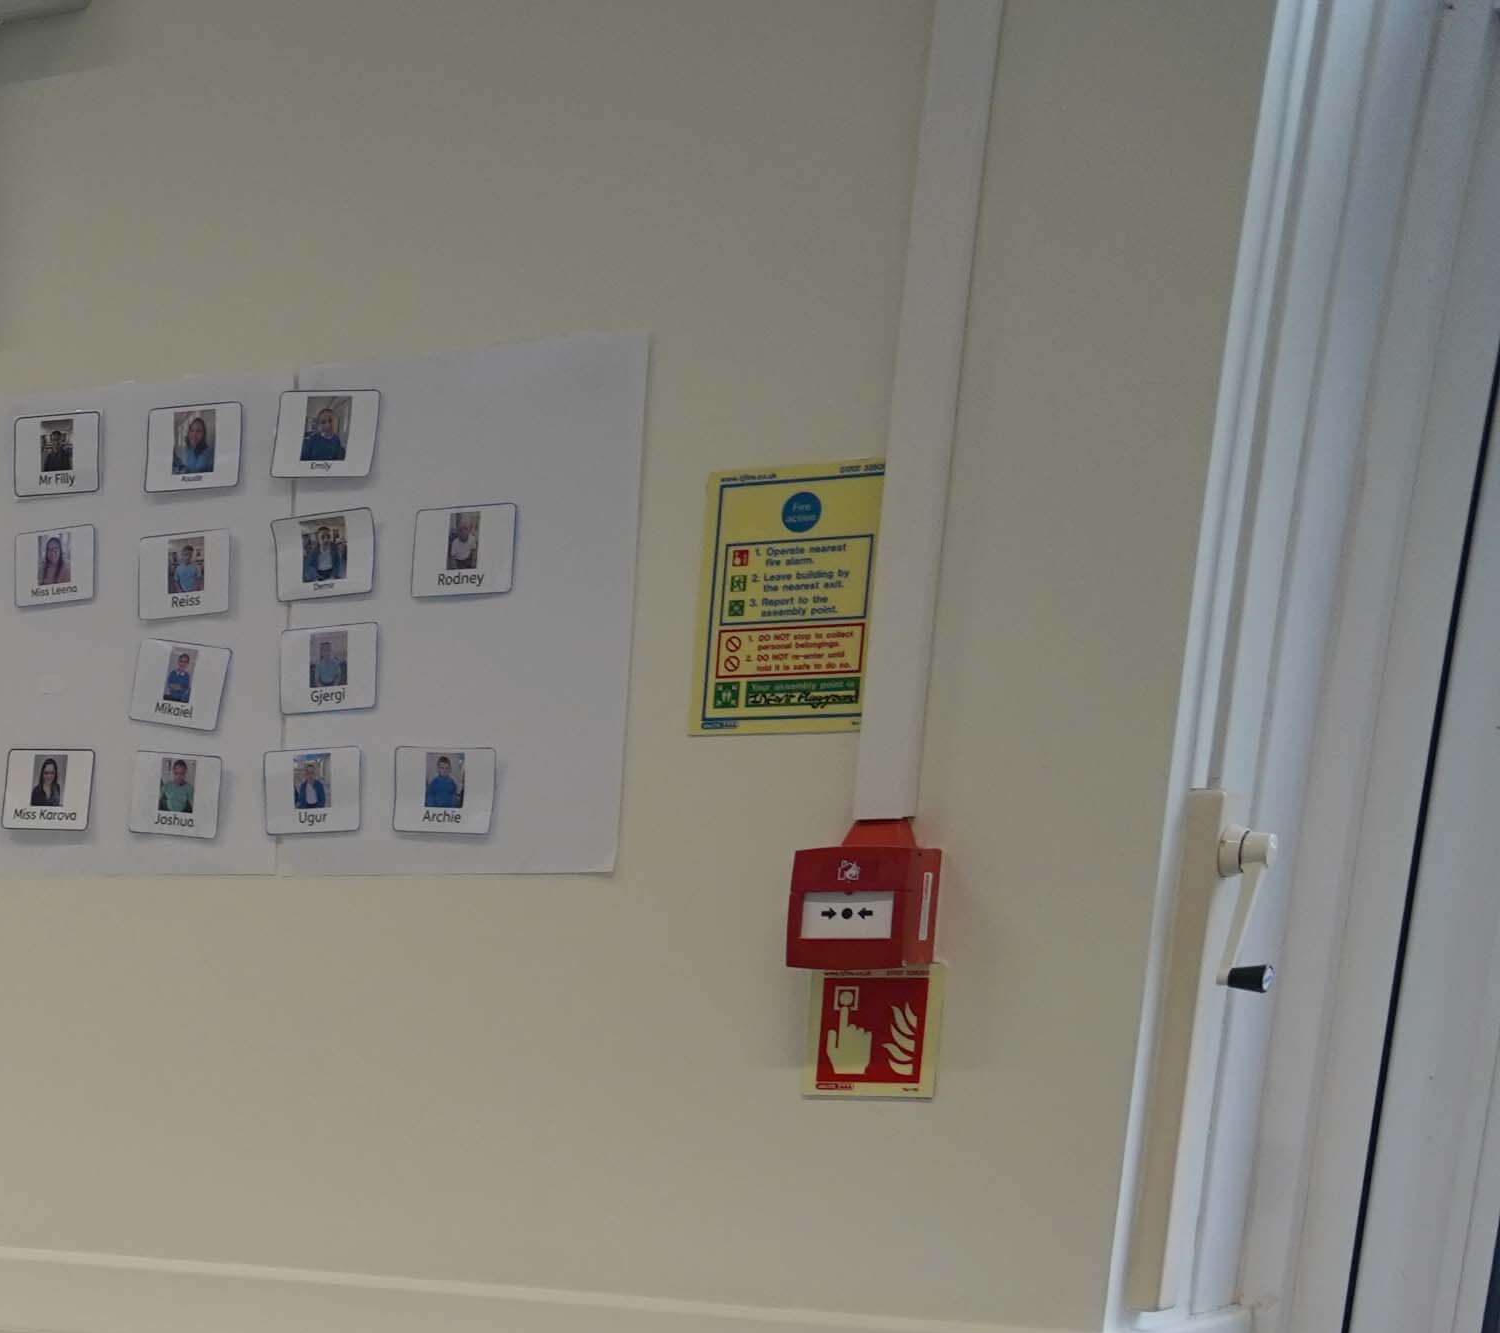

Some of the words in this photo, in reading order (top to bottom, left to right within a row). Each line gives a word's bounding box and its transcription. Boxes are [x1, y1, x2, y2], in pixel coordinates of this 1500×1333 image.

[38, 474, 53, 486] Mr
[54, 472, 76, 488] Filly
[792, 502, 812, 512] Fire
[766, 545, 805, 558] Operate
[808, 543, 847, 554] nearest
[765, 556, 781, 567] fire
[785, 556, 815, 566] alarm.
[437, 571, 485, 588] Rodney
[763, 571, 792, 582] Leave
[795, 569, 835, 582] building
[838, 568, 850, 580] by
[30, 586, 49, 599] Miss
[763, 583, 779, 593] the
[782, 581, 821, 591] nearest
[823, 579, 845, 589] exit.
[171, 594, 201, 610] Reiss
[761, 597, 795, 609] Report
[798, 595, 809, 605] to
[812, 594, 829, 604] the
[761, 605, 807, 618] assembly
[810, 603, 839, 616] point.
[758, 634, 771, 643] DO
[773, 633, 790, 642] NOT
[793, 632, 812, 642] stop
[814, 631, 823, 640] to
[826, 630, 854, 640] collect
[757, 641, 793, 651] personal
[795, 639, 840, 651] belongings.
[757, 654, 769, 662] DO
[772, 653, 789, 662] NOT
[791, 651, 825, 661] re-enter
[827, 650, 846, 660] until
[756, 663, 772, 672] told
[792, 662, 811, 671] safe
[813, 662, 823, 671] to
[825, 661, 837, 670] do
[751, 681, 771, 691] Your
[773, 680, 816, 692] assembly
[820, 679, 845, 690] point
[310, 687, 346, 704] Gjergi
[12, 808, 37, 822] Miss
[39, 808, 77, 822] Karova
[154, 812, 195, 828] Joshua
[298, 810, 327, 825] Ugur
[422, 808, 462, 825] Archie
